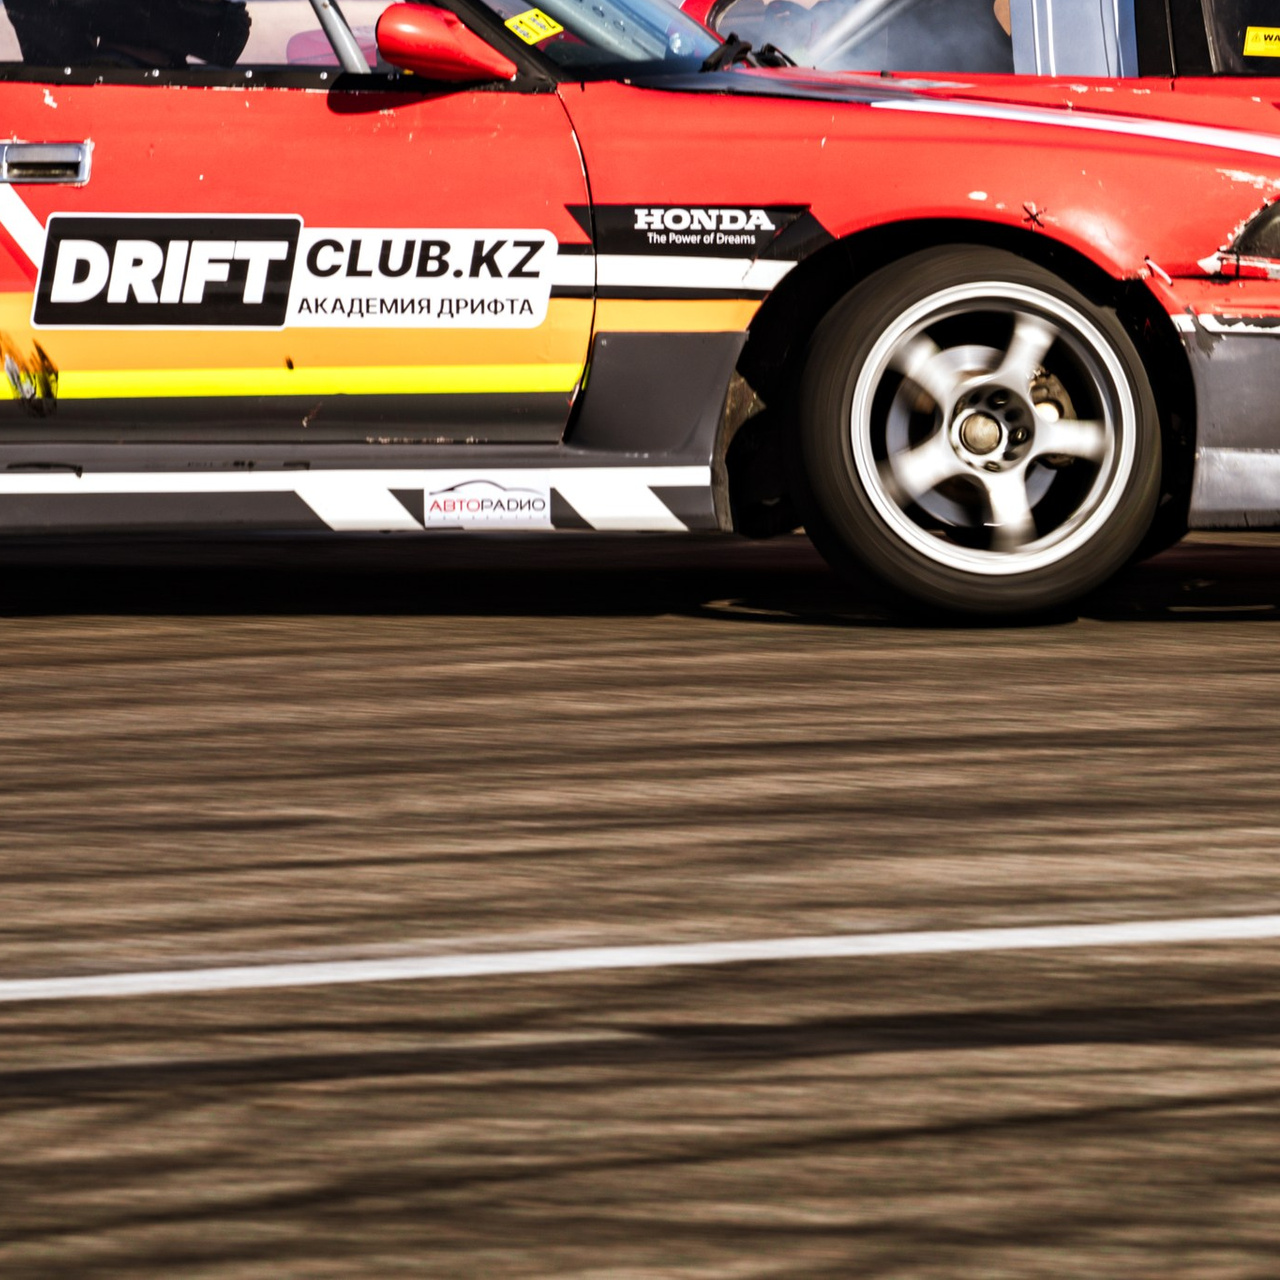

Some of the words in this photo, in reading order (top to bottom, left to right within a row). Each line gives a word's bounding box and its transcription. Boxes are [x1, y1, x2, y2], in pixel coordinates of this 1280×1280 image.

[634, 208, 776, 231] HONDA
[647, 232, 667, 245] The
[669, 232, 701, 245] Power
[703, 232, 715, 245] of
[716, 233, 756, 245] Dreams
[306, 238, 546, 279] CLUB.KZ
[50, 239, 289, 304] DRIFT
[298, 297, 431, 319] АКАДЕМИЯ
[437, 298, 534, 319] ДРИФТА
